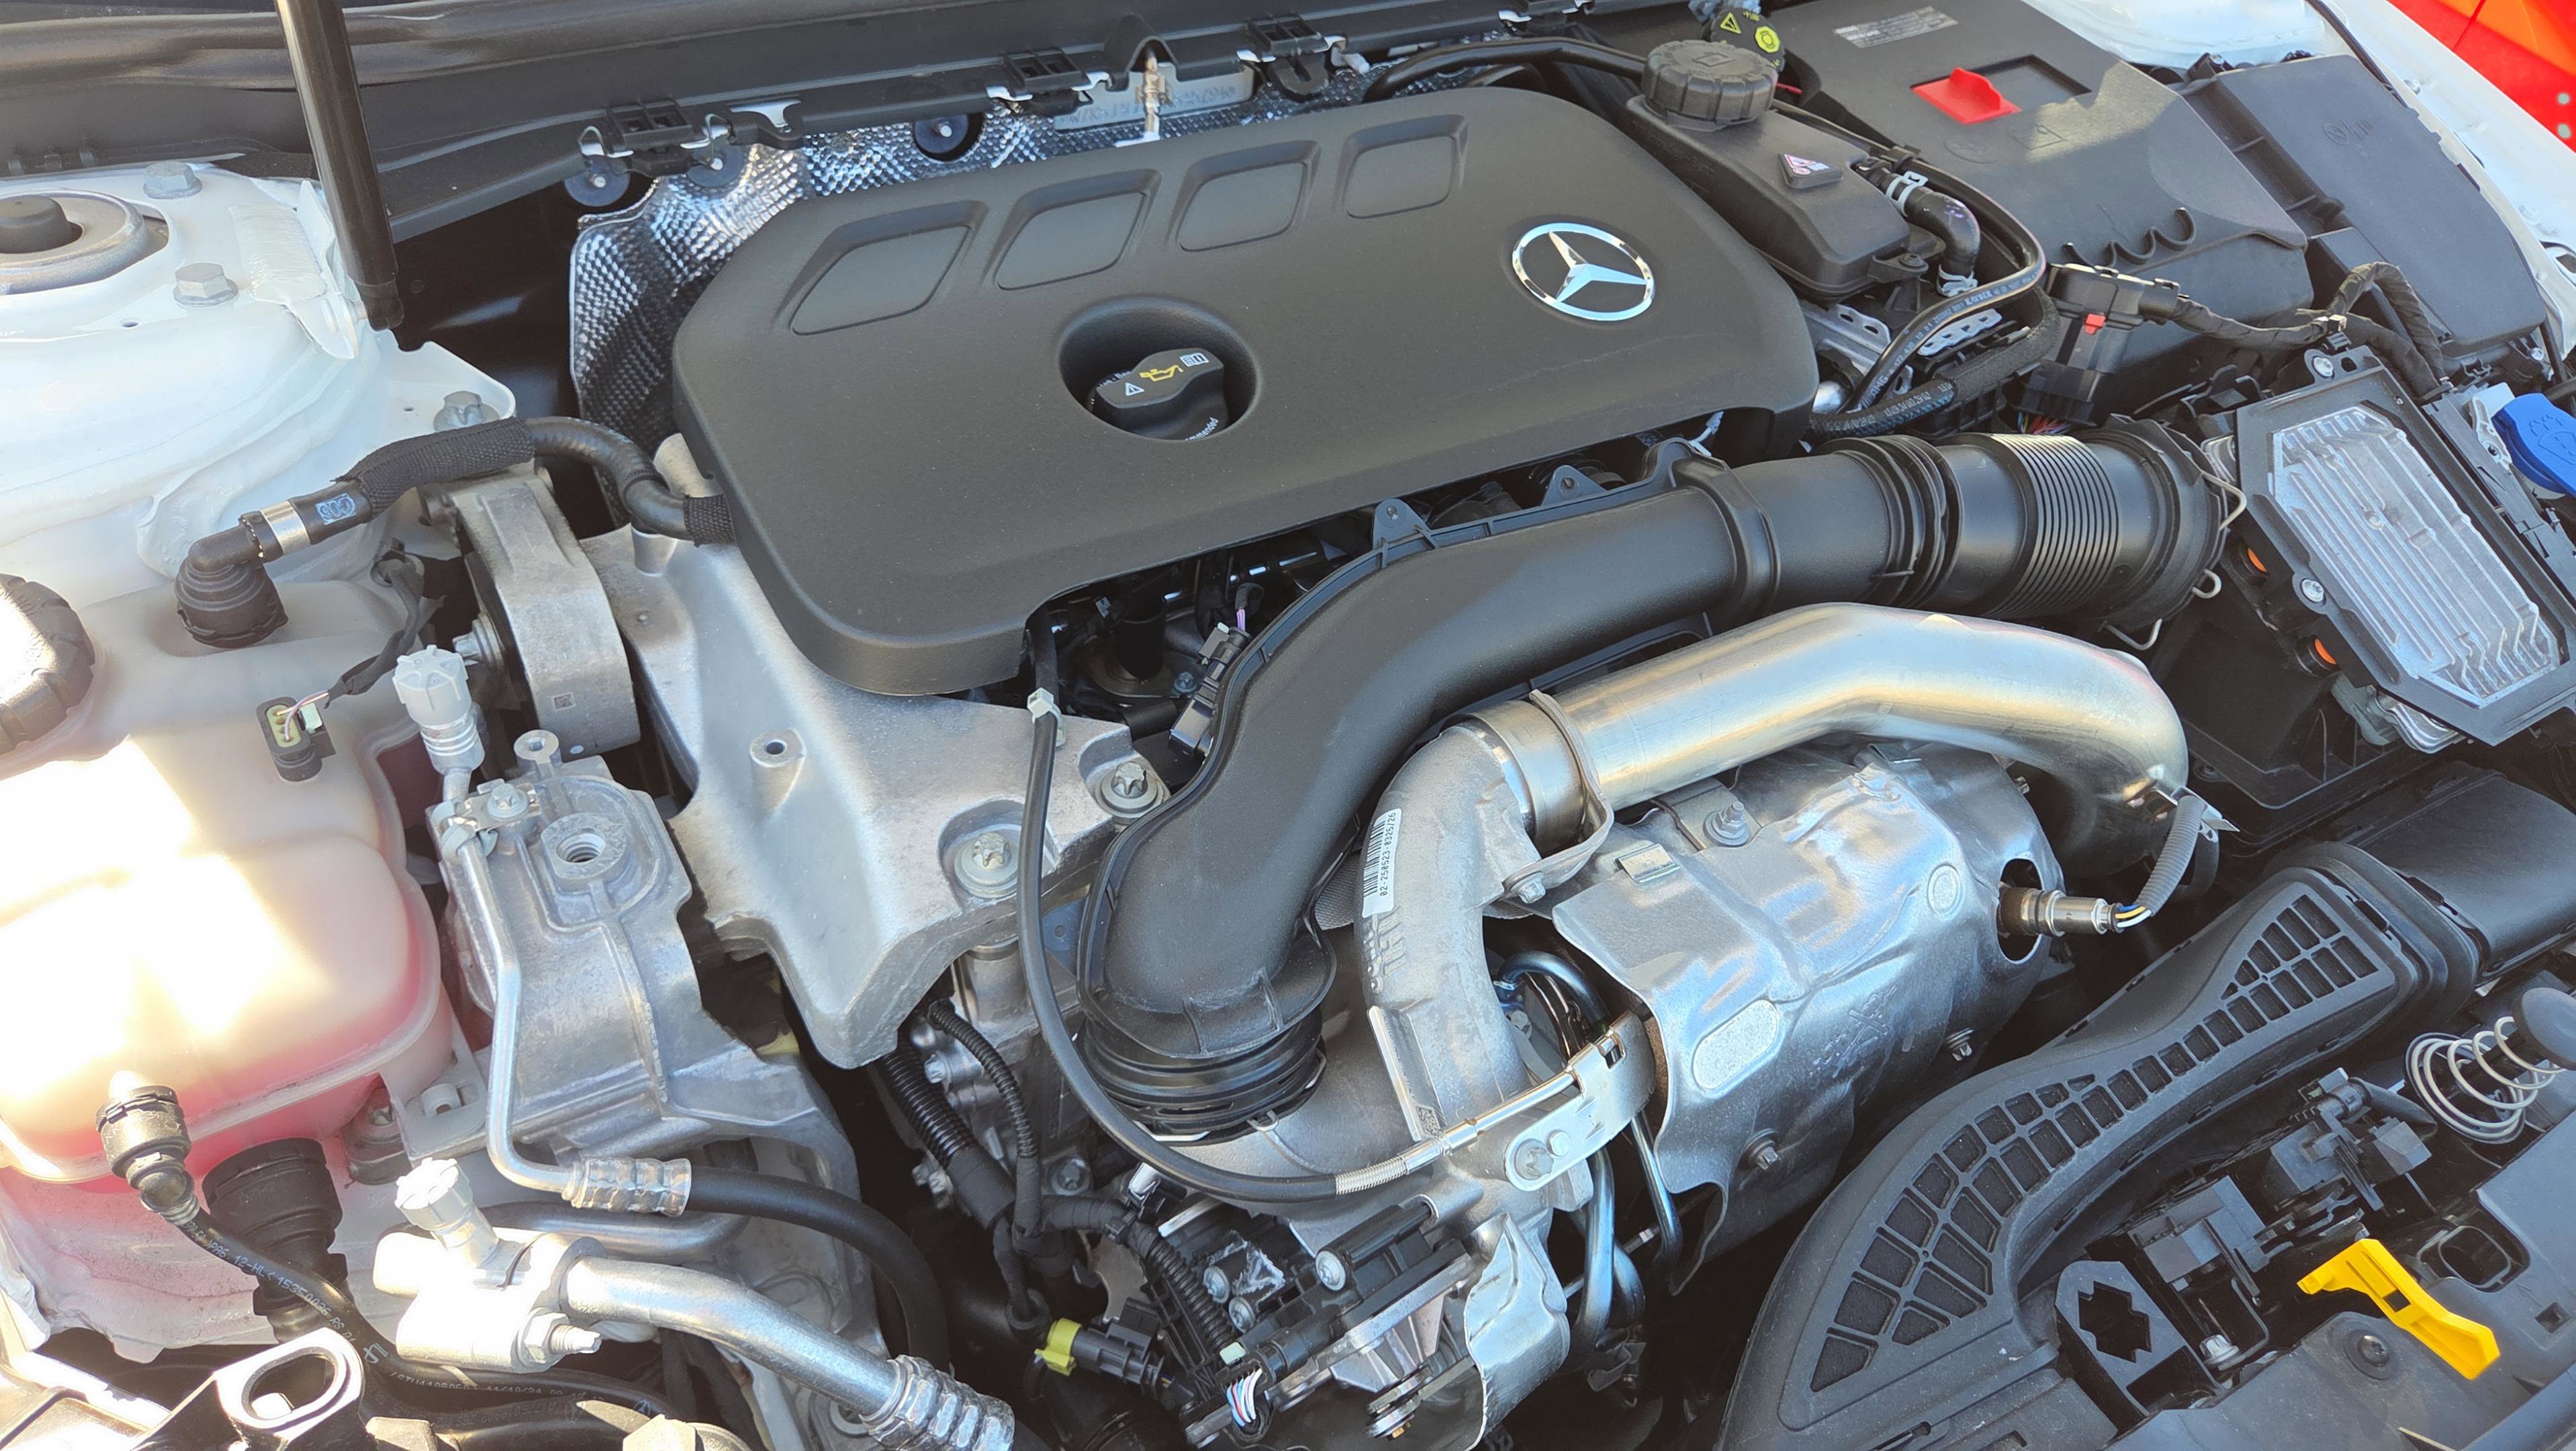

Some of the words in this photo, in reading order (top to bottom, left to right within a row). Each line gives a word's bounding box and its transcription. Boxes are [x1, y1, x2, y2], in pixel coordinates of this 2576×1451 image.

[1869, 374, 1888, 398] AMG
[1915, 332, 1924, 340] 10
[1964, 290, 1994, 306] KAYSER
[1379, 811, 1396, 897] 02-250523-0325/26
